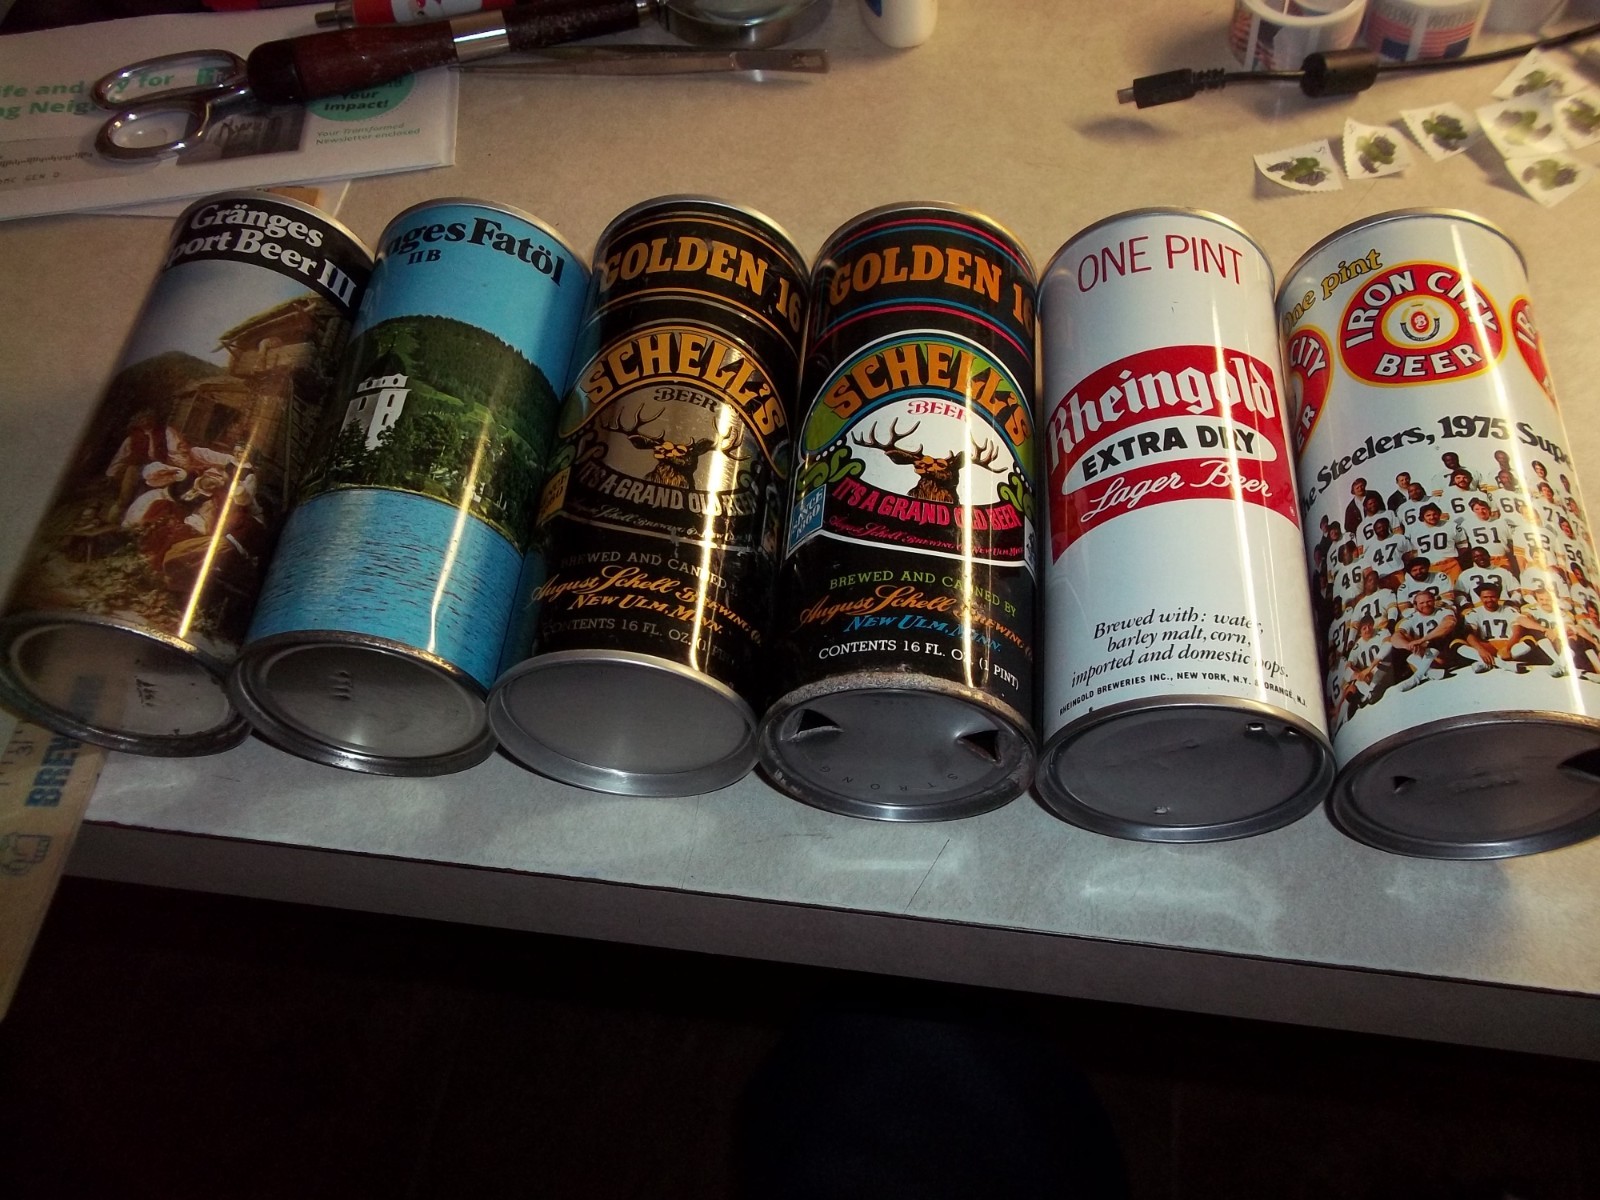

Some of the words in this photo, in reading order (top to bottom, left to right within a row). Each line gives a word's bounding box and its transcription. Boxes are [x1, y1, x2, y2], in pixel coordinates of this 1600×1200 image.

[36, 80, 86, 96] and
[139, 74, 175, 89] for
[324, 99, 390, 111] Impact!
[315, 132, 373, 146] Newsletter
[375, 127, 421, 140] enclosed
[317, 129, 340, 138] Your
[343, 122, 405, 135] Transformed
[190, 204, 325, 249] Gränges
[232, 229, 317, 273] Beer
[315, 258, 358, 308] III
[468, 217, 566, 288] Fatöl
[1078, 236, 1152, 292] ONE
[1165, 234, 1243, 285] PINT
[602, 236, 769, 296] GOLDEN
[775, 277, 802, 333] 16
[830, 245, 1002, 306] GOLDEN
[1321, 248, 1384, 301] pint
[1345, 270, 1416, 350] IRON
[1426, 270, 1499, 333] CITY
[1290, 335, 1327, 379] CITY
[1374, 343, 1483, 379] BEER
[581, 333, 786, 436] SCHELL'S
[653, 386, 719, 413] BEER
[822, 343, 1030, 447] SCHELL'S
[1051, 357, 1275, 476] Rheingold
[1081, 427, 1188, 482] EXTRA
[1195, 425, 1255, 454] DRY
[1317, 423, 1436, 494] Steelers,
[1437, 414, 1509, 440] 1975
[614, 480, 684, 511] GRAND
[832, 476, 863, 507] IT'S
[860, 490, 880, 512] A
[877, 496, 950, 527] GRAND
[988, 503, 1024, 531] BEER
[1081, 471, 1186, 523] Lager
[1190, 459, 1273, 498] Beer
[1372, 543, 1398, 566] 47
[1416, 531, 1449, 553] 50
[1472, 526, 1501, 546] 51
[573, 565, 681, 595] Schell
[627, 552, 662, 567] AND
[668, 557, 728, 589] CANED
[1341, 565, 1362, 590] 46
[566, 593, 620, 611] NEW
[797, 594, 874, 631] August
[848, 584, 957, 614] Schell
[830, 570, 895, 591] BREWED
[900, 570, 936, 585] AND
[942, 576, 1001, 606] CANED
[1004, 602, 1018, 618] BY
[621, 619, 639, 632] 16
[642, 623, 663, 636] FL.
[843, 614, 900, 634] NEW
[1093, 608, 1155, 640] Brewed
[1159, 606, 1207, 624] with:
[1107, 628, 1158, 653] barley
[1162, 625, 1208, 643] malt,
[1210, 630, 1252, 647] corn,
[1481, 619, 1509, 640] 17
[818, 639, 897, 660] CONTENTS
[903, 640, 921, 653] 16
[925, 643, 946, 658] FL.
[993, 664, 1019, 691] PINT)
[1071, 650, 1134, 688] imported
[1137, 643, 1174, 665] and
[1177, 643, 1251, 665] domestic
[1359, 645, 1381, 667] 10
[1059, 689, 1095, 717] RHEINGOLD
[1097, 676, 1147, 695] BREWERIES
[1149, 672, 1174, 682] INC.,
[1177, 671, 1199, 680] NEW
[1202, 672, 1231, 684] YORK,
[1233, 675, 1252, 685] N.Y.
